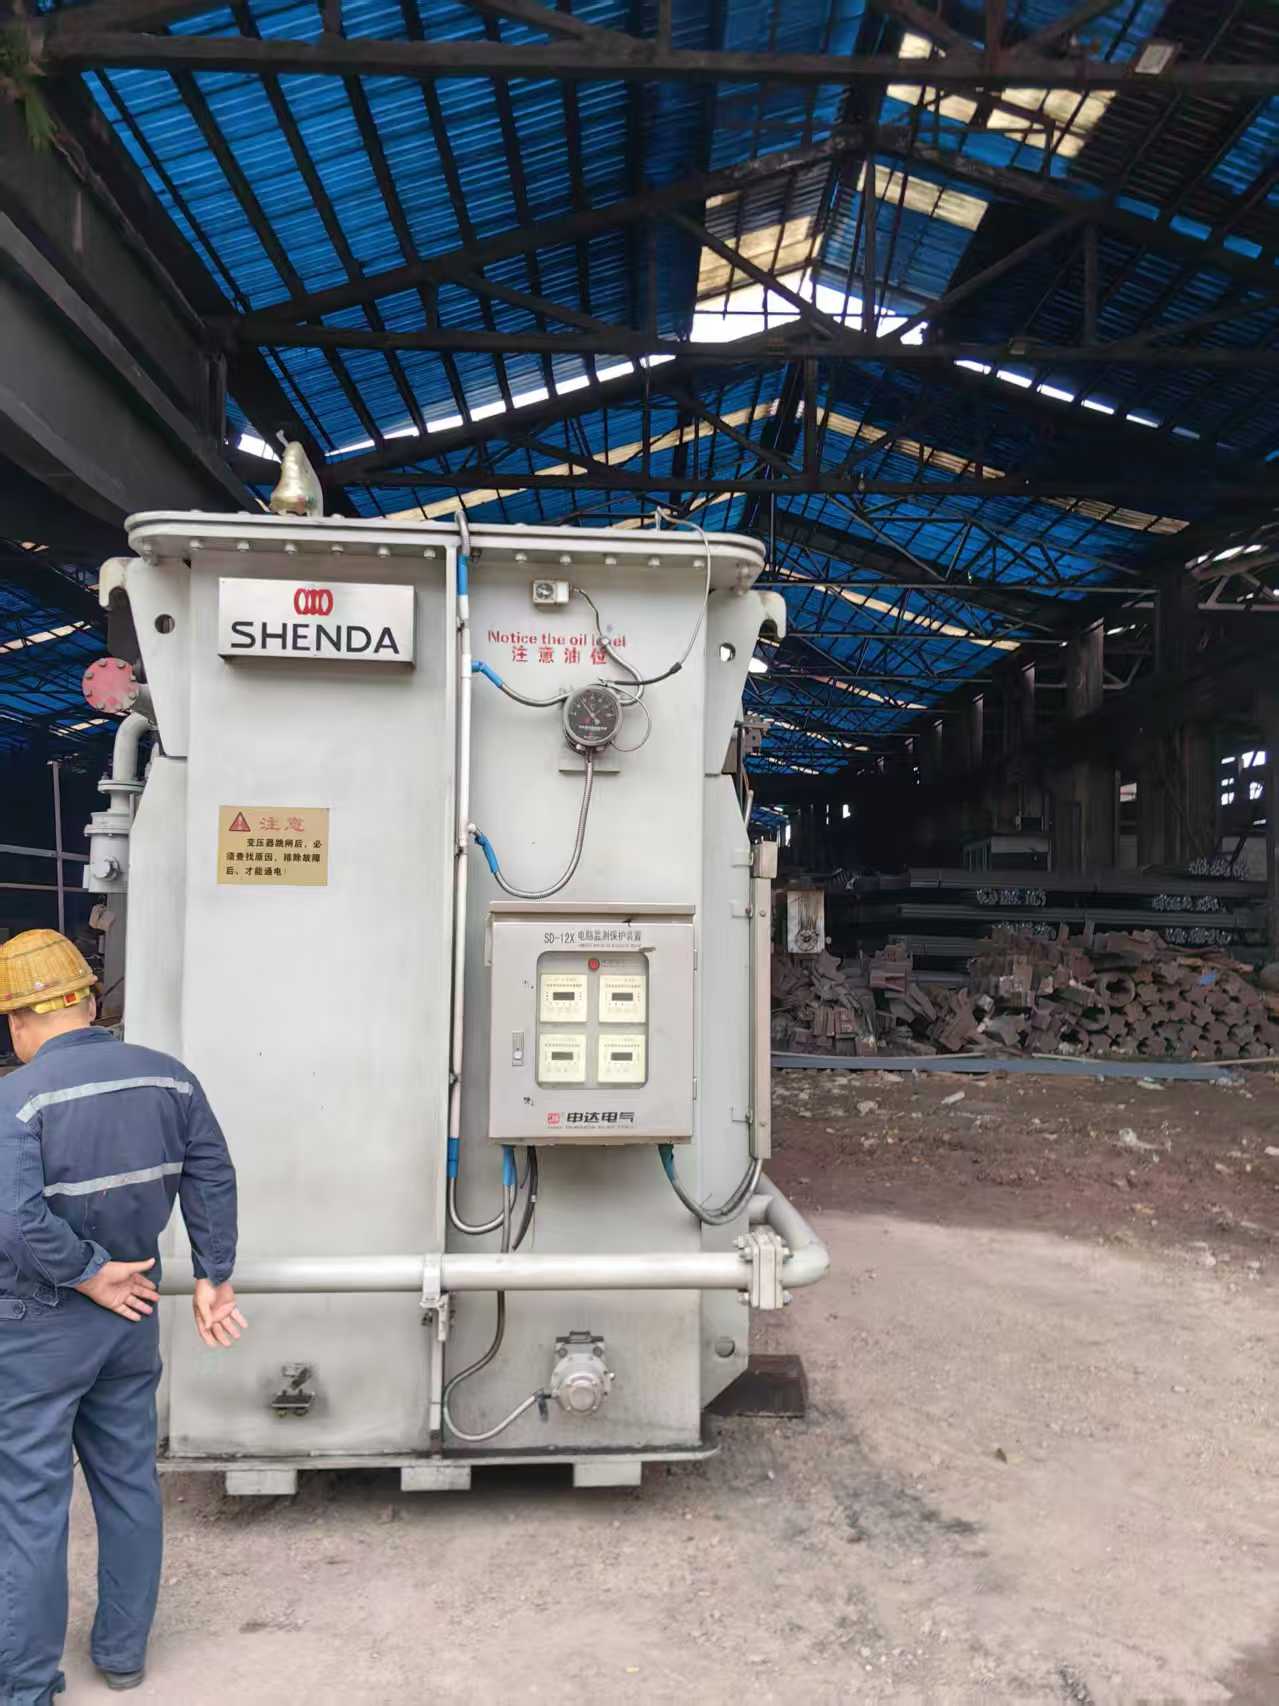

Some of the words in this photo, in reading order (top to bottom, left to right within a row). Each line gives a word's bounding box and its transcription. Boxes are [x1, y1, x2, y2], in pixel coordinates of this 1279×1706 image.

[231, 621, 400, 654] SHENDA
[488, 630, 538, 645] Notice
[542, 632, 566, 646] the
[570, 633, 587, 647] oil
[512, 646, 608, 665] 注意油位
[259, 816, 305, 832] 注意
[567, 1111, 635, 1123] 申达电气
